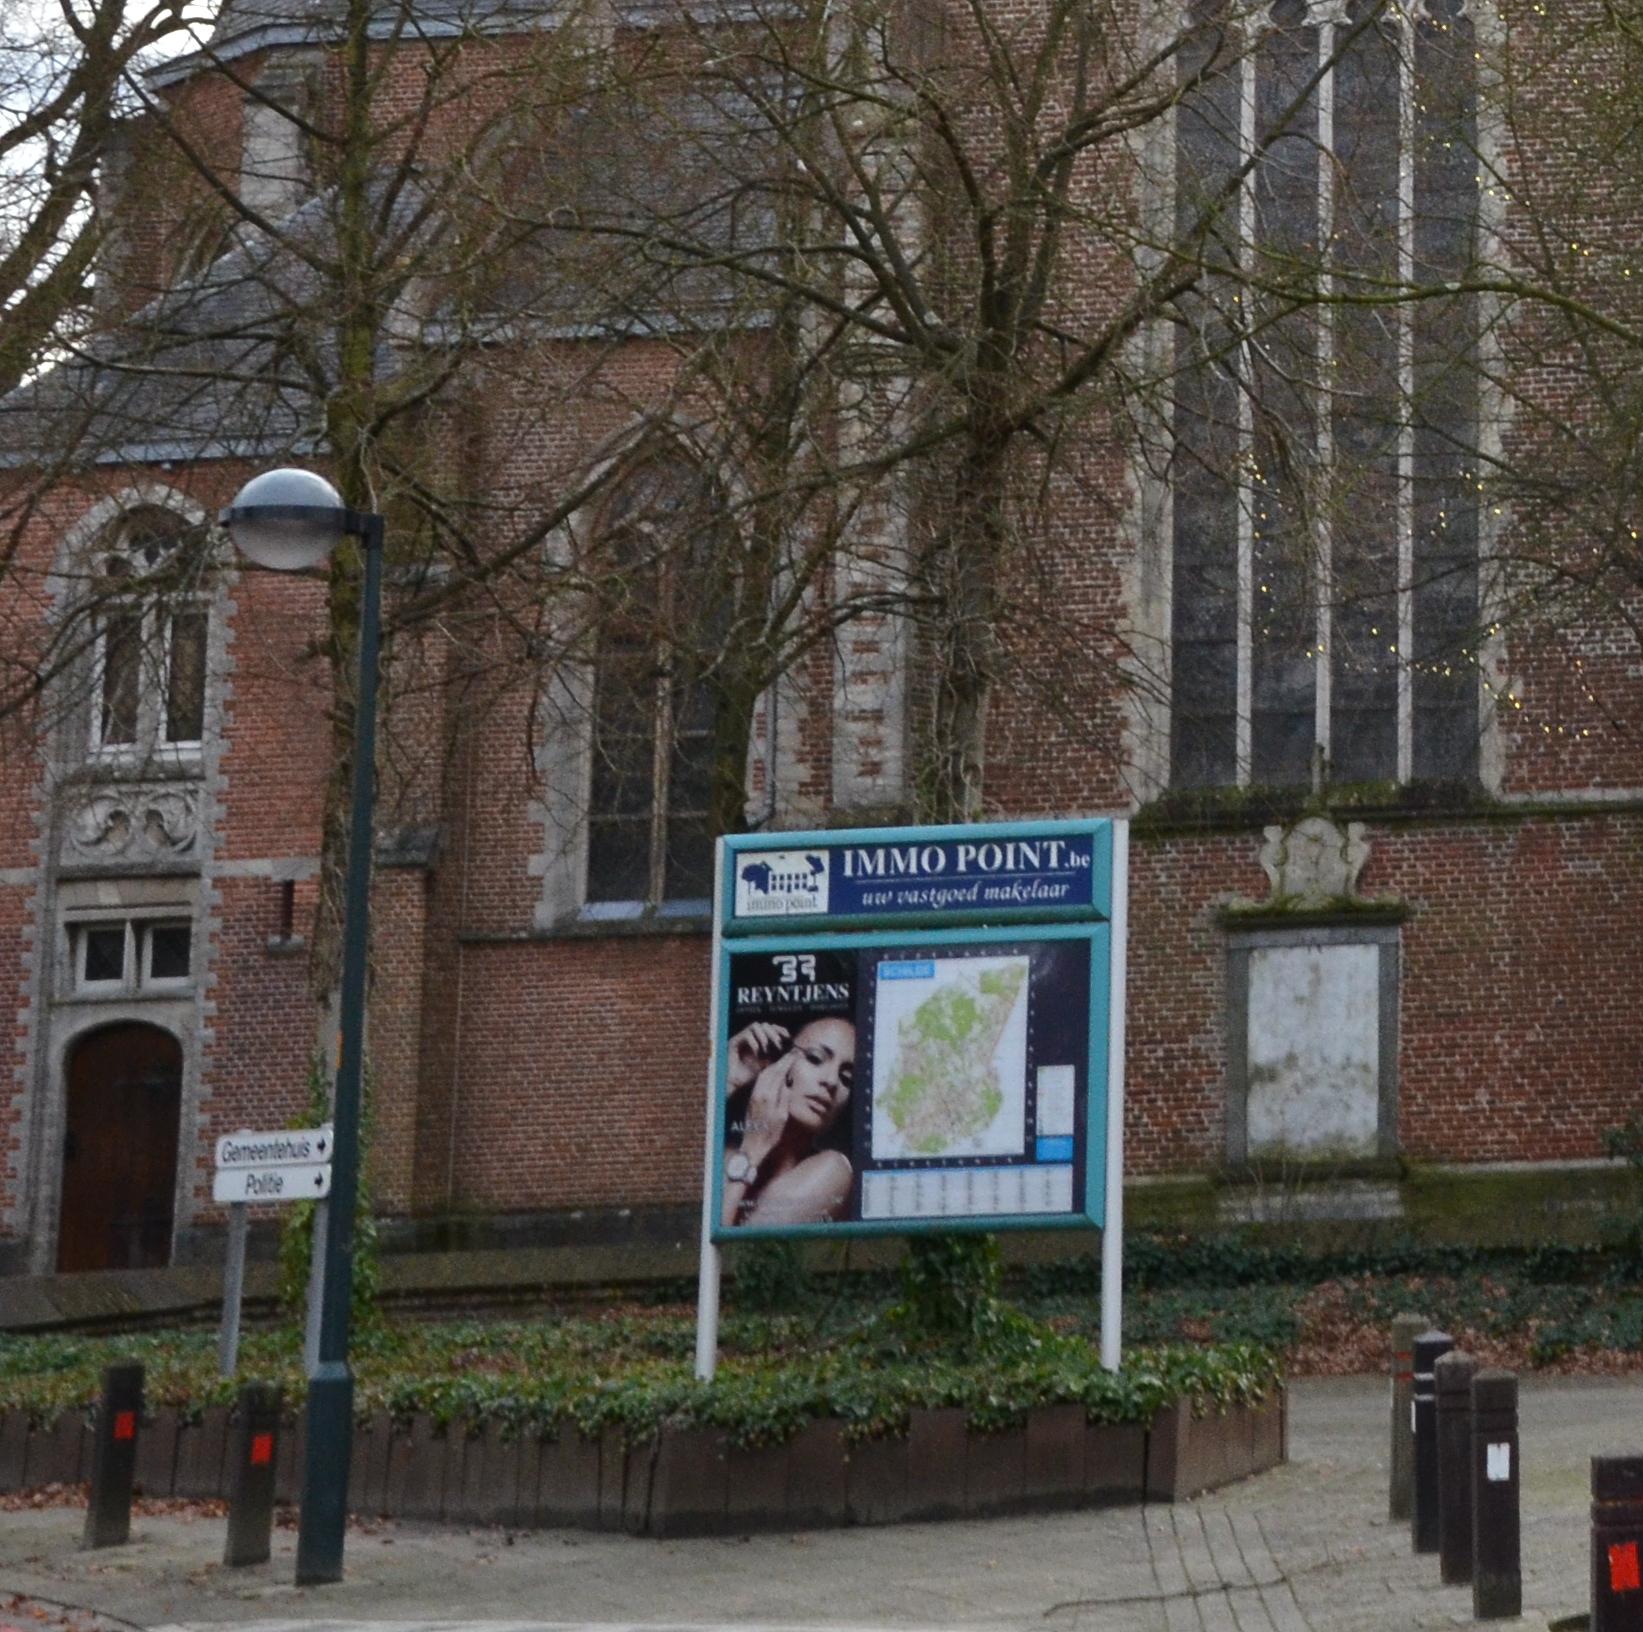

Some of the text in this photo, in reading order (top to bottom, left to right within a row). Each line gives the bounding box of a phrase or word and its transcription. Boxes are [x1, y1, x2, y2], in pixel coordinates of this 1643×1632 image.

[843, 845, 946, 877] IMMO
[747, 894, 819, 913] immo point
[862, 878, 1070, 909] uw vastgoed makelaar
[738, 983, 849, 1004] REYNTJENS
[222, 1137, 311, 1163] Gemeentehuis
[245, 1172, 284, 1196] Politie
